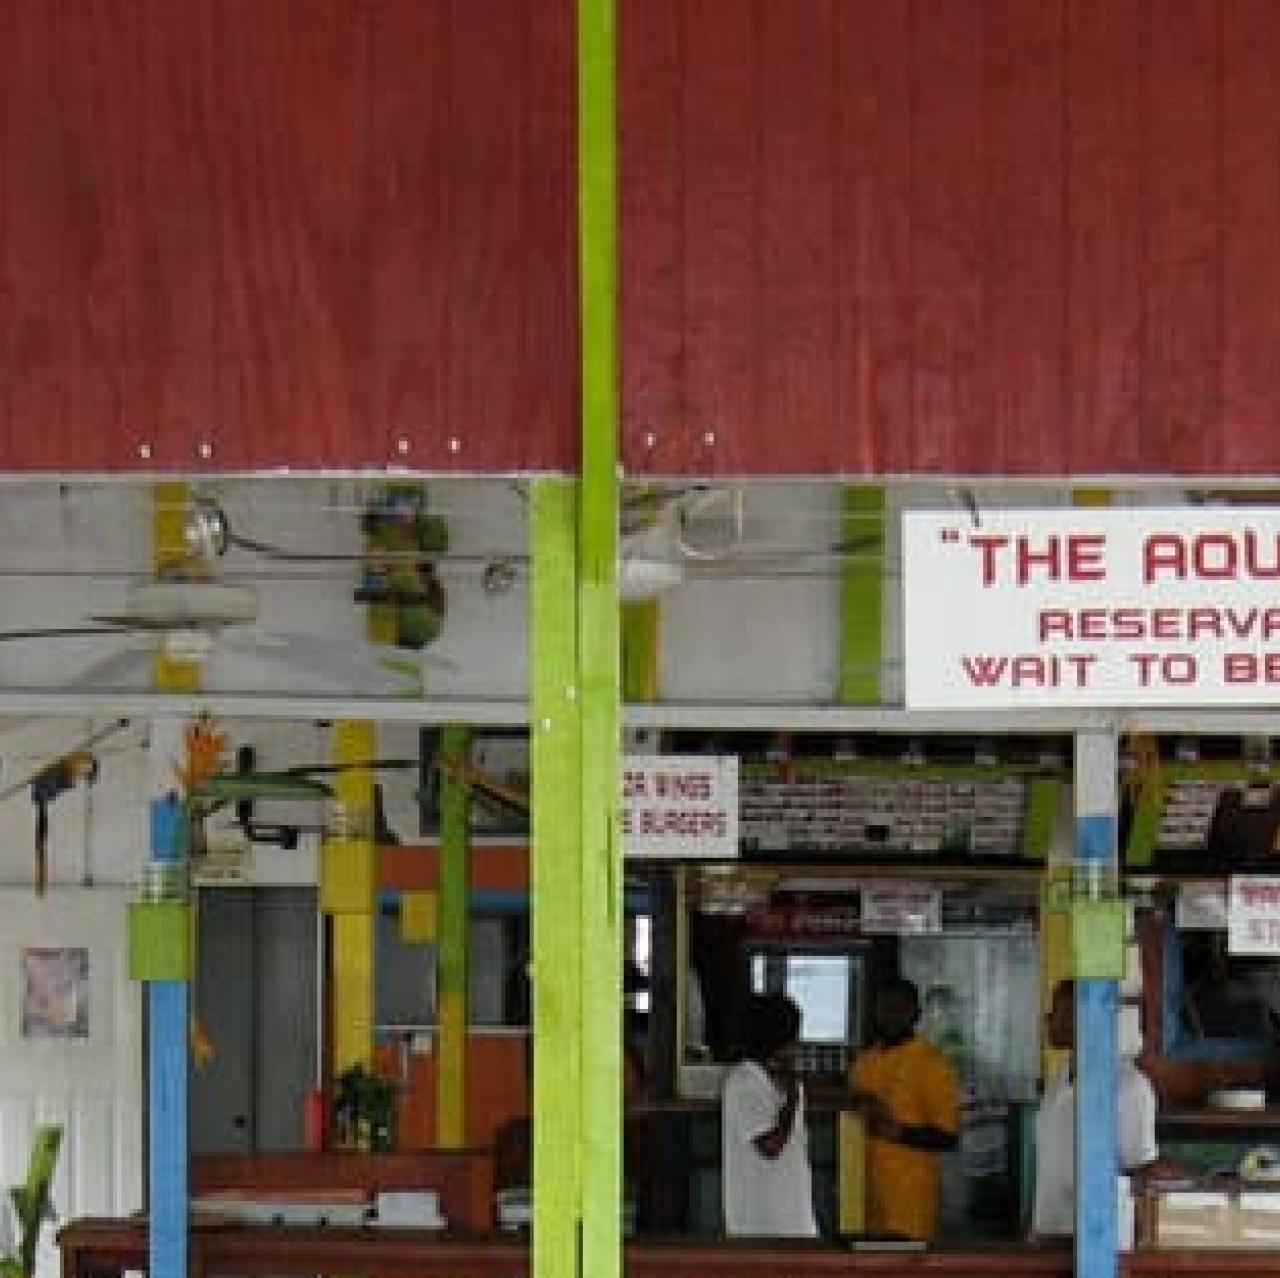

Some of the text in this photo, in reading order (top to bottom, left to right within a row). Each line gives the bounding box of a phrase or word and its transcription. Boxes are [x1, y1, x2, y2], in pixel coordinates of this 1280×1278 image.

[940, 529, 1107, 587] "THE
[962, 653, 1097, 688] WAIT
[1133, 653, 1197, 686] TO
[639, 808, 727, 838] BURGERS
